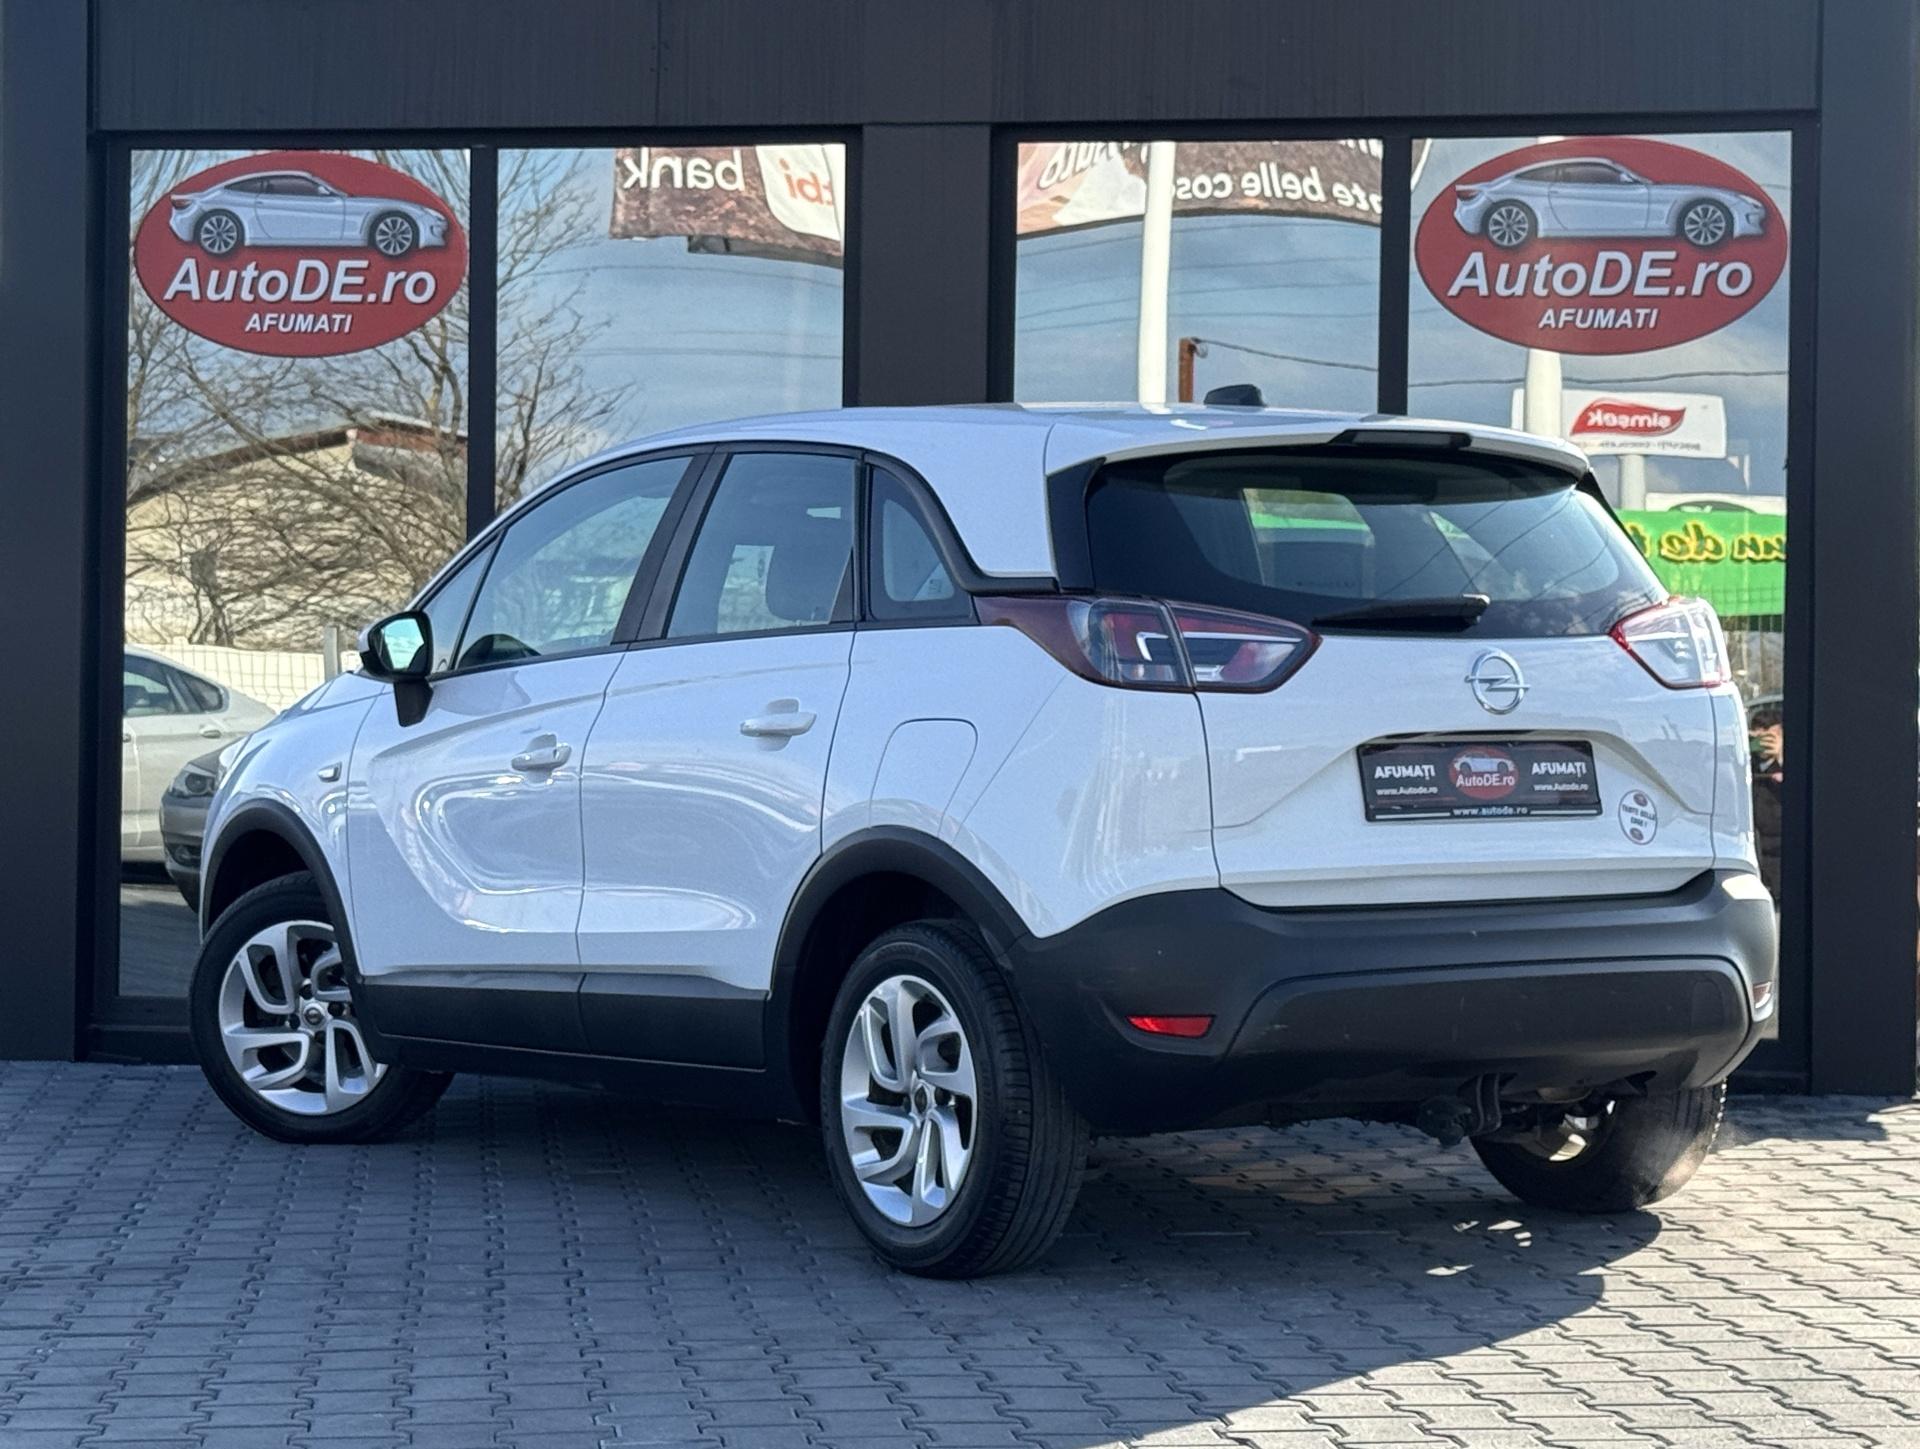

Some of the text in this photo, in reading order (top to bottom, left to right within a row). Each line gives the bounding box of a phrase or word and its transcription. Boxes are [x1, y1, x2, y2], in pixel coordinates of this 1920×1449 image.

[163, 257, 437, 304] AutoDE.ro
[1447, 250, 1753, 298] AutoDE.ro
[245, 313, 352, 334] AFUMATI
[1537, 308, 1660, 329] AFUMATI
[1376, 786, 1438, 796] www.Autode.ro
[1456, 773, 1516, 788] AutoDE.ro
[1453, 806, 1528, 815] www.autode.ro
